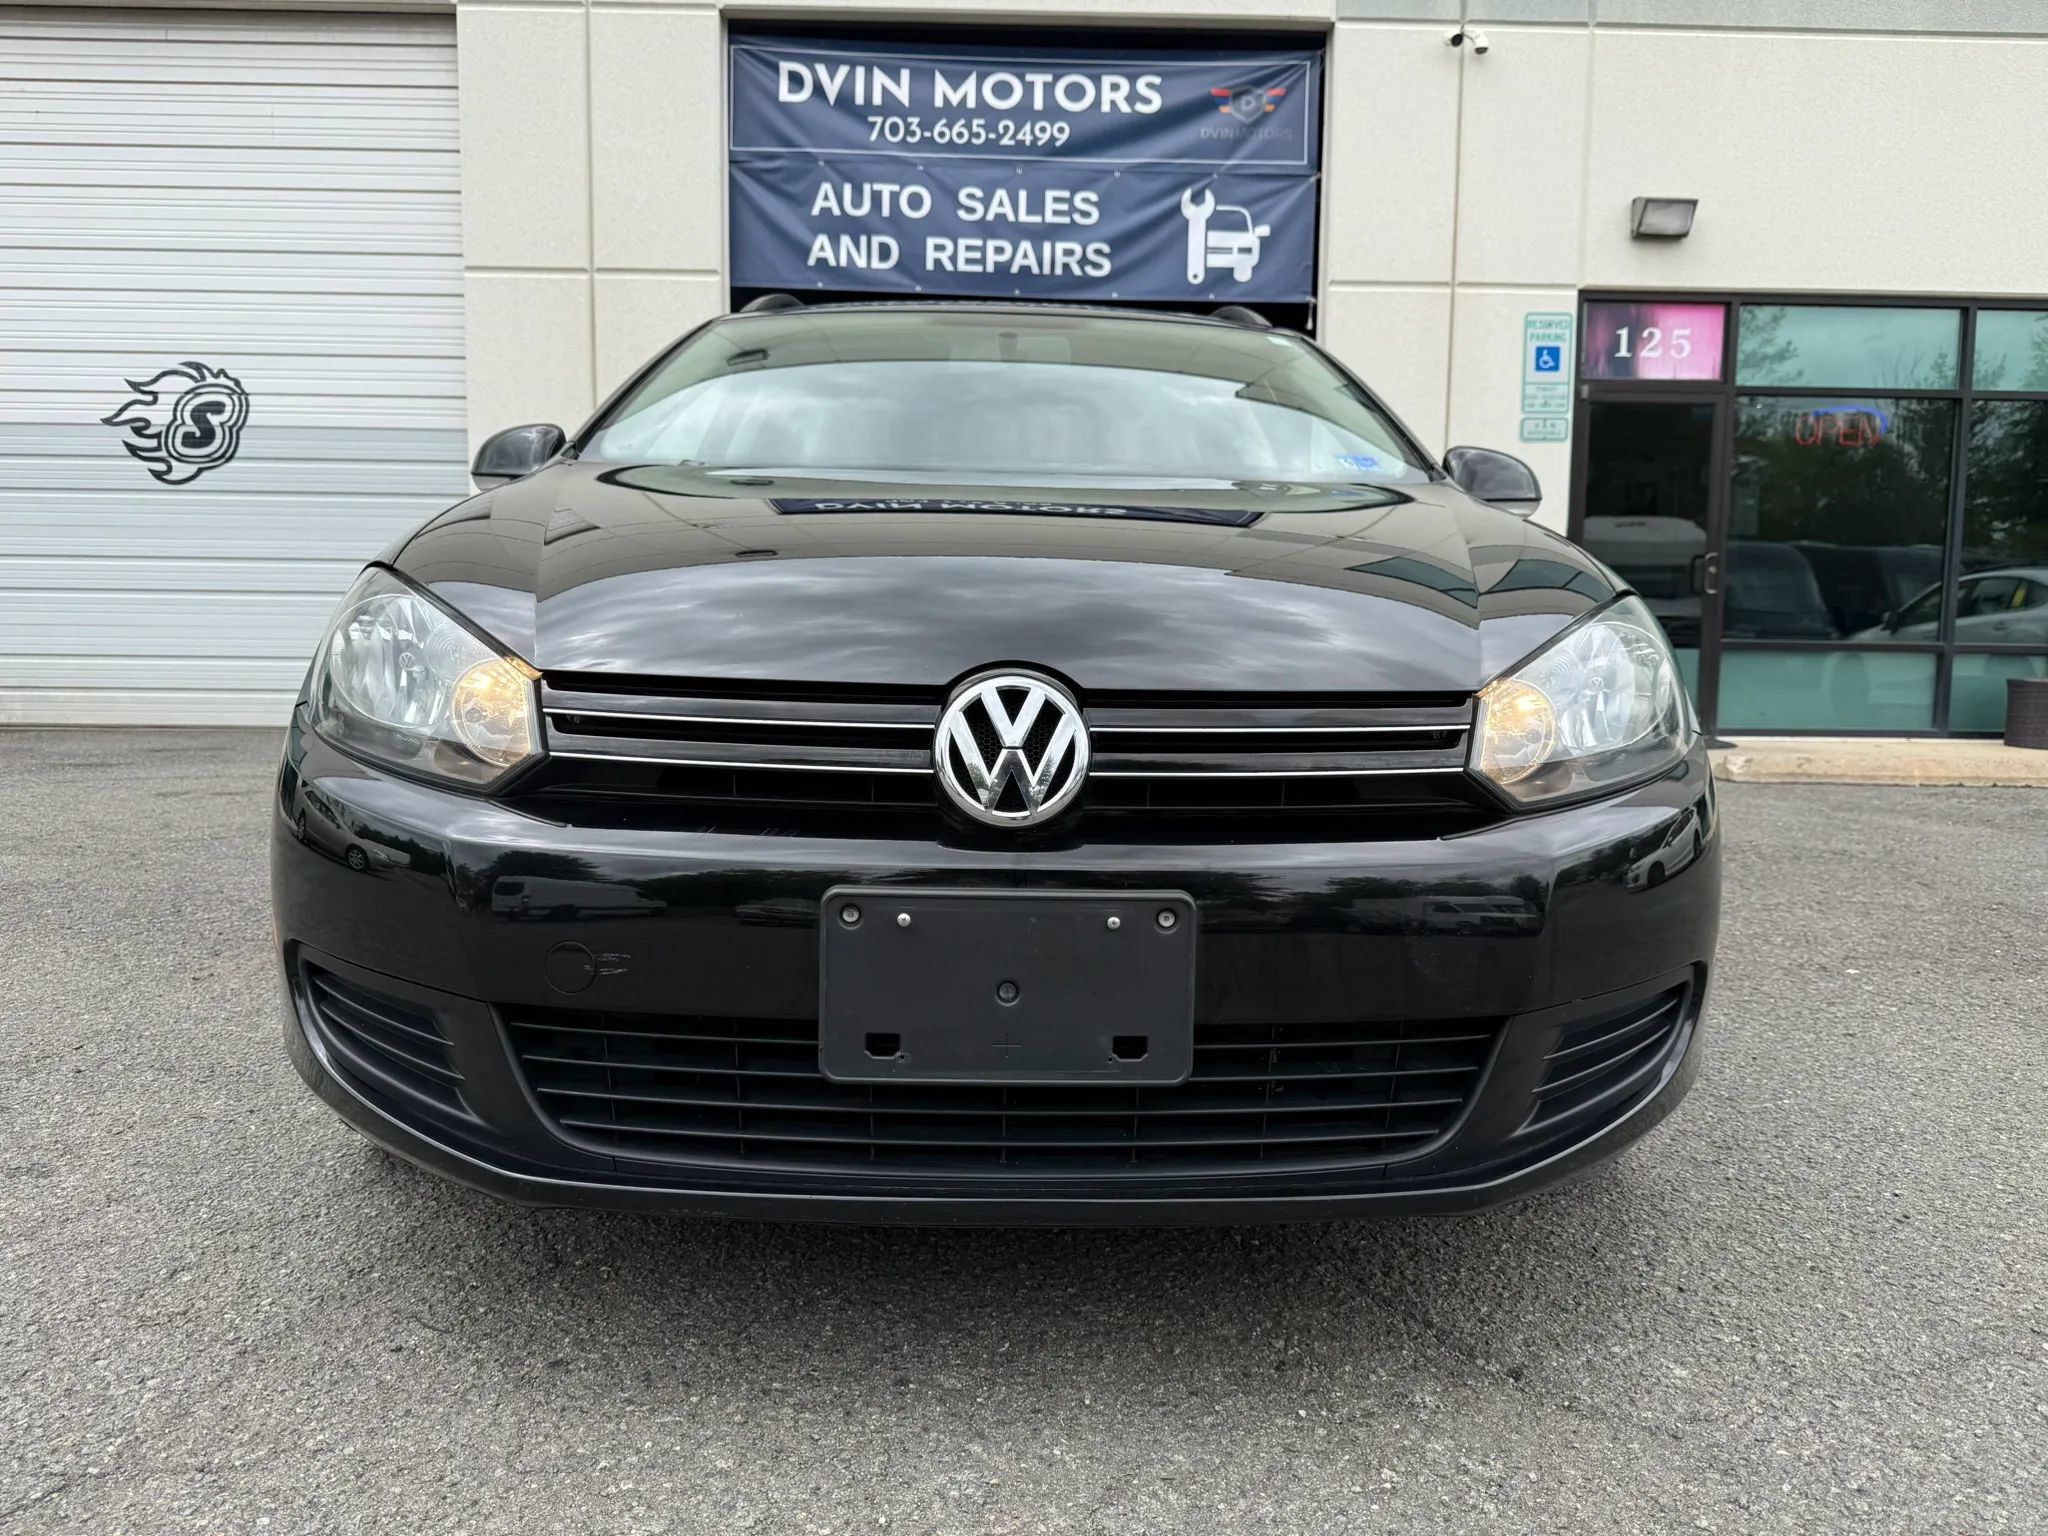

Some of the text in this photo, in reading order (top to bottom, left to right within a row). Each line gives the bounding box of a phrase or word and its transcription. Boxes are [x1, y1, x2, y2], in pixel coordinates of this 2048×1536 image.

[777, 60, 1163, 115] DVIN MOTORS
[867, 115, 1071, 147] 703-665-2499
[810, 181, 1101, 225] AUTO SALES
[806, 233, 1113, 278] AND REPAIRS
[1613, 325, 1693, 359] 125
[1794, 413, 1881, 447] OPEN
[944, 682, 1082, 817] VW
